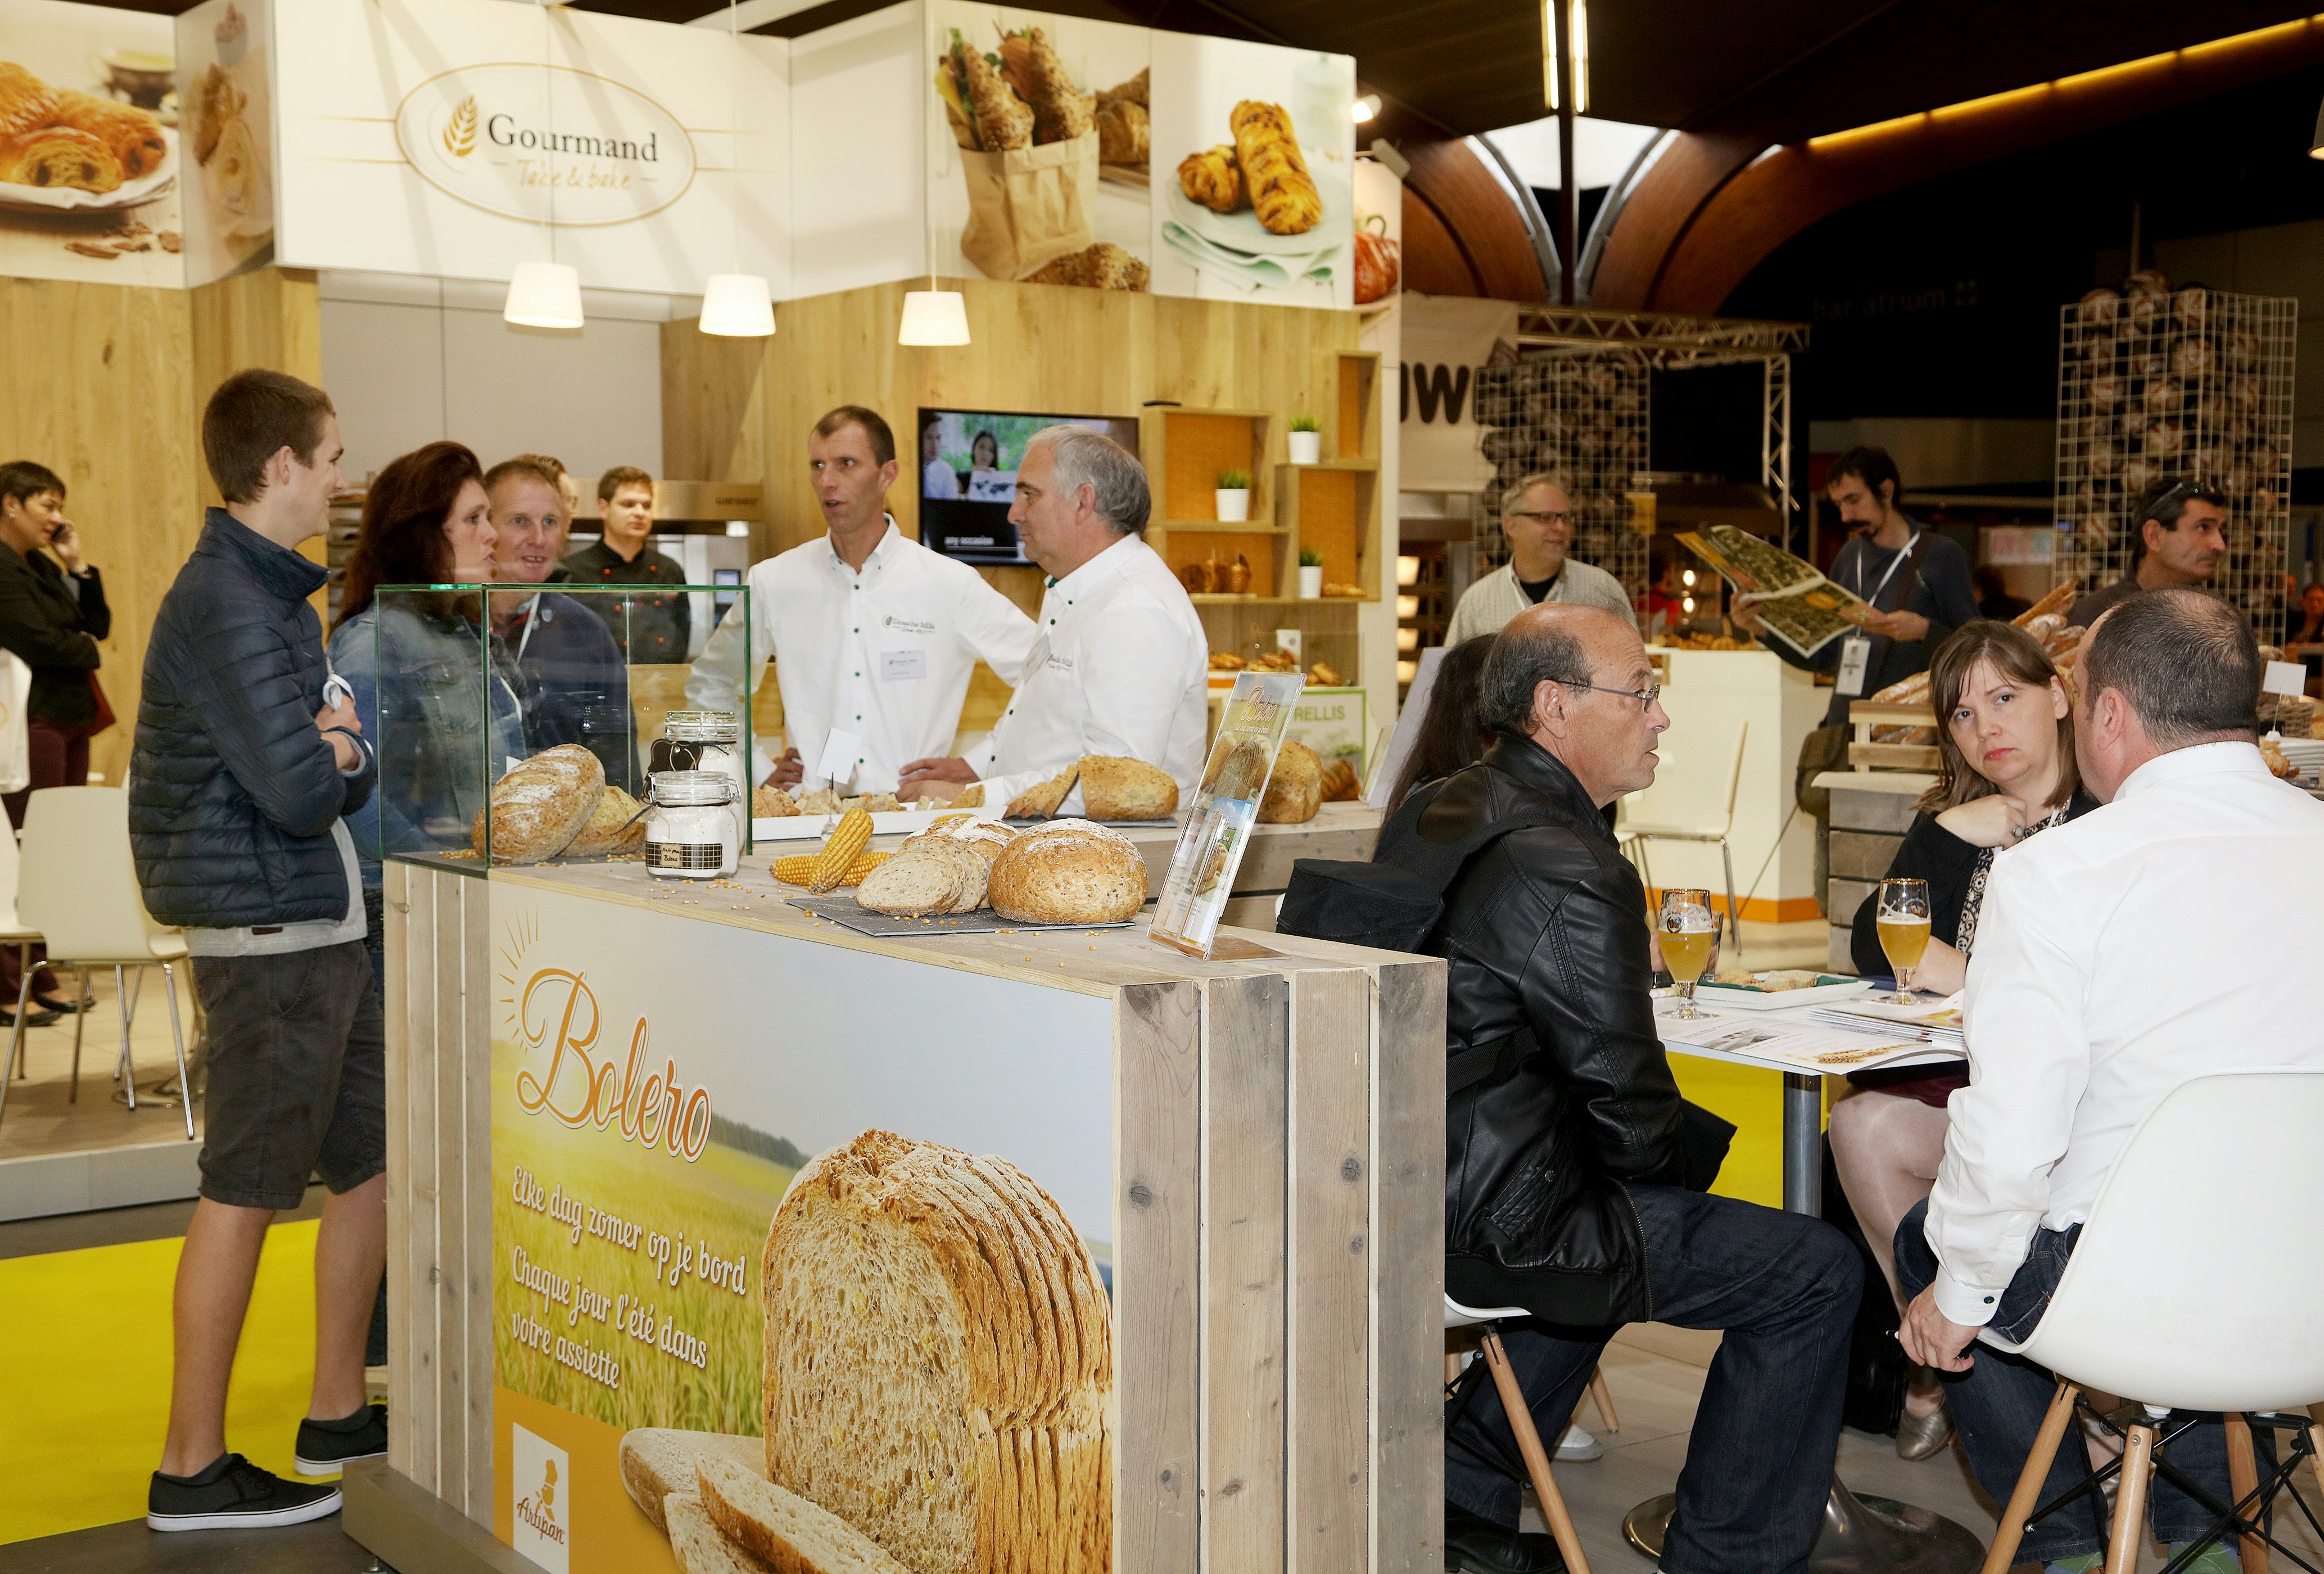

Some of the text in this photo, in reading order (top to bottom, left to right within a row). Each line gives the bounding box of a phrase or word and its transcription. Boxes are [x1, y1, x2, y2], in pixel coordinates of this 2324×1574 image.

[488, 114, 659, 162] Gourmand
[517, 159, 631, 189] Take & bake
[1862, 287, 1946, 317] atrium
[1241, 685, 1277, 721] Bolero
[516, 967, 711, 1161] Bolero
[512, 1165, 745, 1295] Elke dag zomer op je bord
[512, 1245, 707, 1368] Chaque jour l'été dans
[512, 1312, 619, 1389] votre assiette
